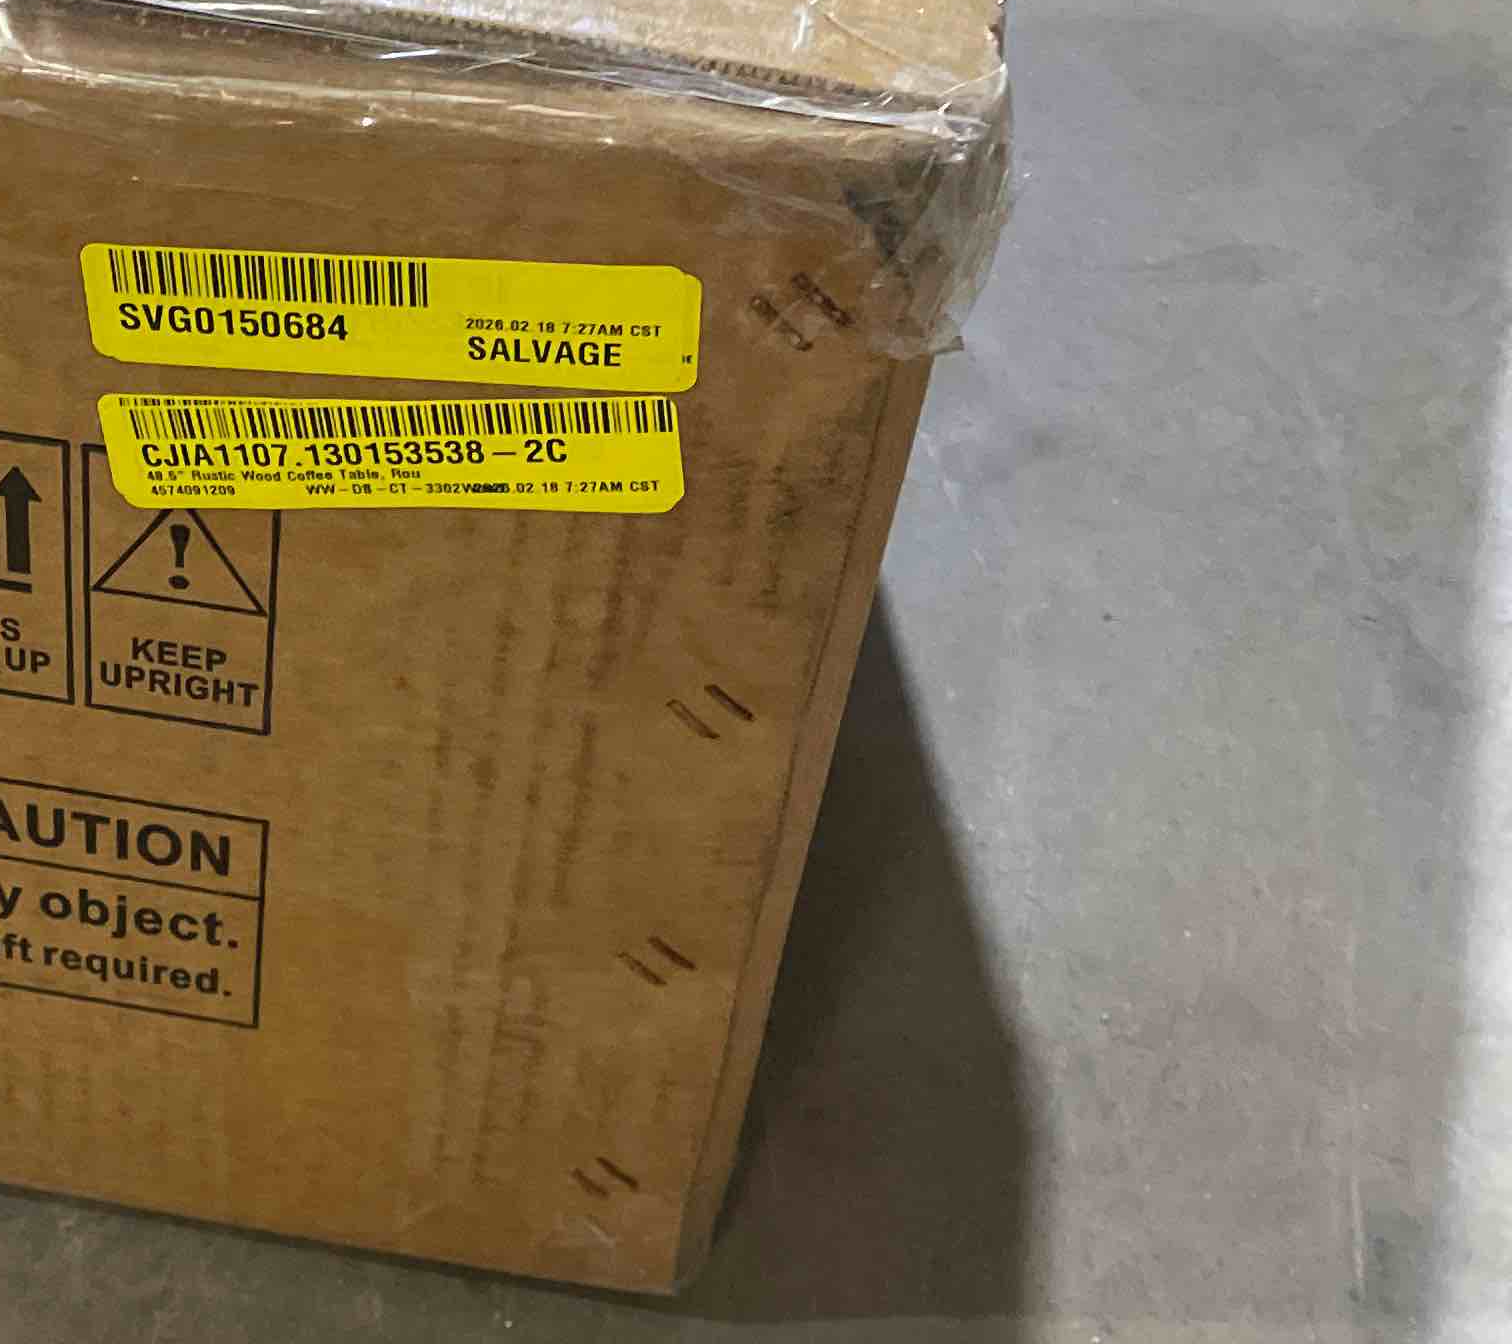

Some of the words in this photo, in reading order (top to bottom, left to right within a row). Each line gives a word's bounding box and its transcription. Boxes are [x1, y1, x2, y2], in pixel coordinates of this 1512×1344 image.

[118, 302, 348, 341] SVG0150684
[630, 325, 662, 337] CST
[468, 335, 621, 367] SALVAGE
[241, 470, 281, 482] Wood
[629, 479, 661, 493] CST
[3, 646, 52, 675] UP
[131, 637, 227, 672] KEEP
[99, 662, 260, 707] UPRIGHT
[39, 888, 239, 950] object.
[43, 944, 233, 998] required.
